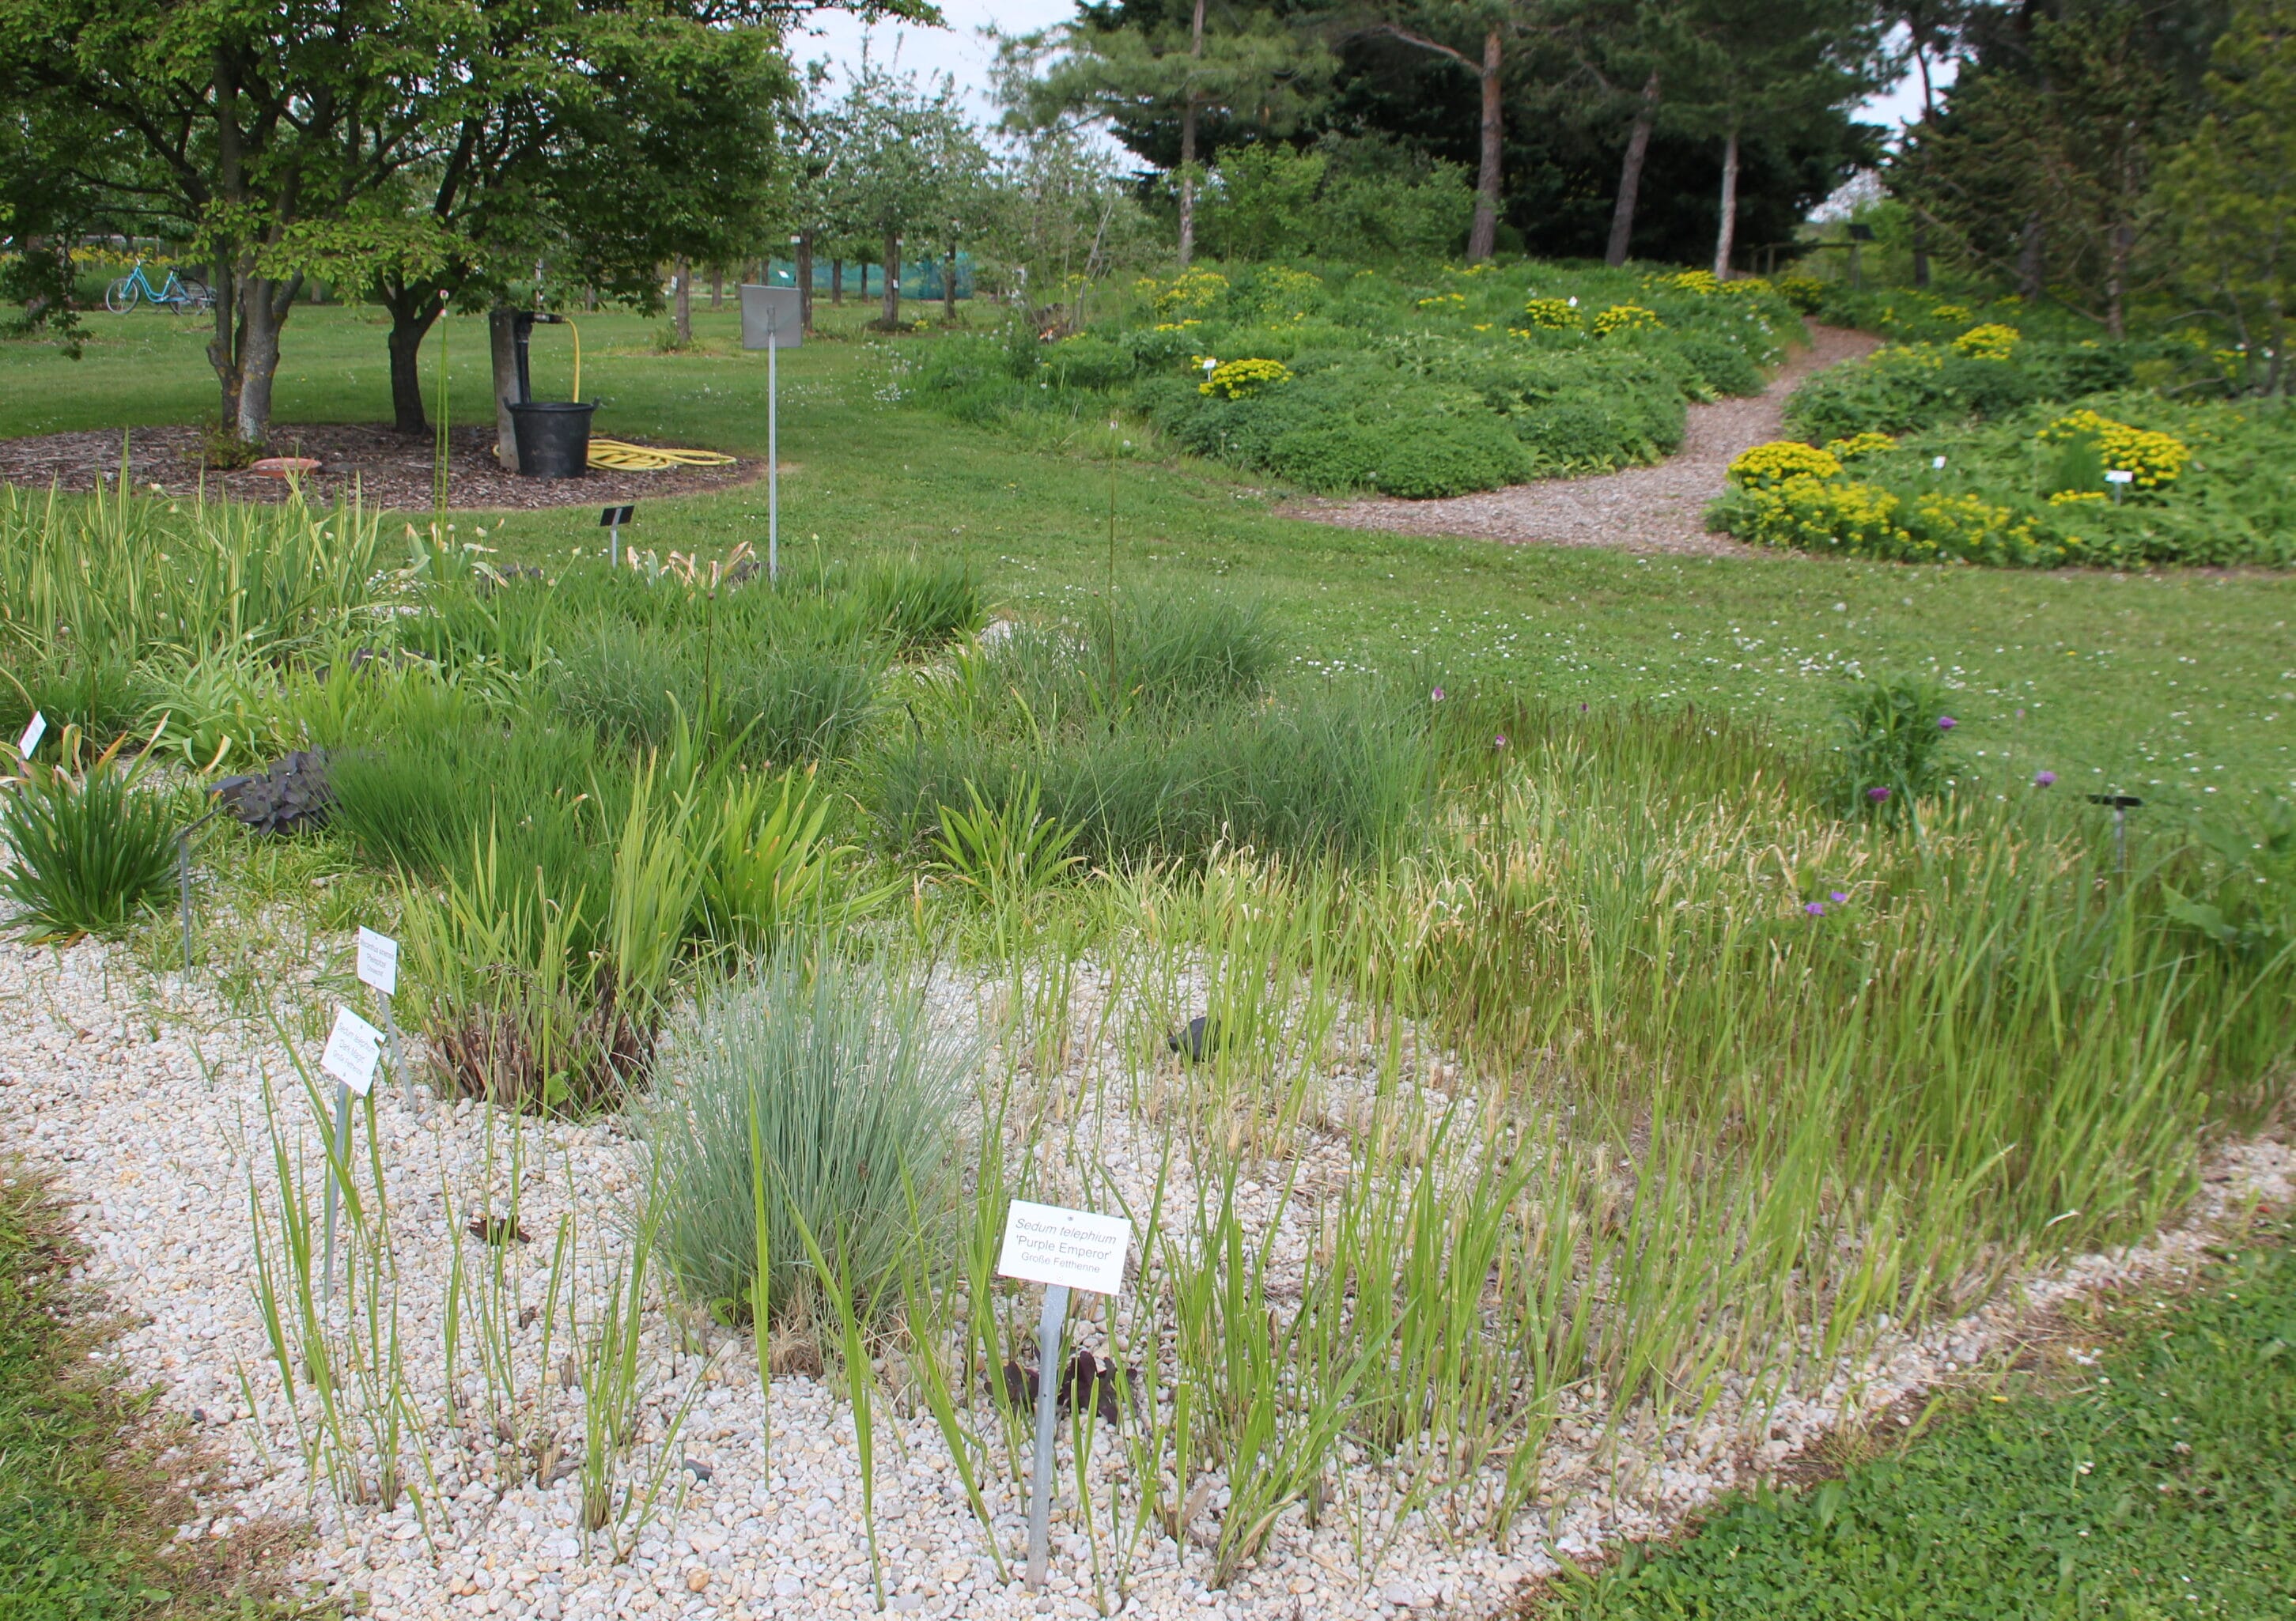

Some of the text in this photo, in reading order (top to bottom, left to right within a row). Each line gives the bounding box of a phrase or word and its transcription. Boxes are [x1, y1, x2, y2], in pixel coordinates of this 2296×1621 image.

[1016, 1219, 1117, 1245] Sedum telephium
[1016, 1235, 1112, 1260] 'Purple Emperor'
[1021, 1252, 1100, 1273] Große Fetthenne
